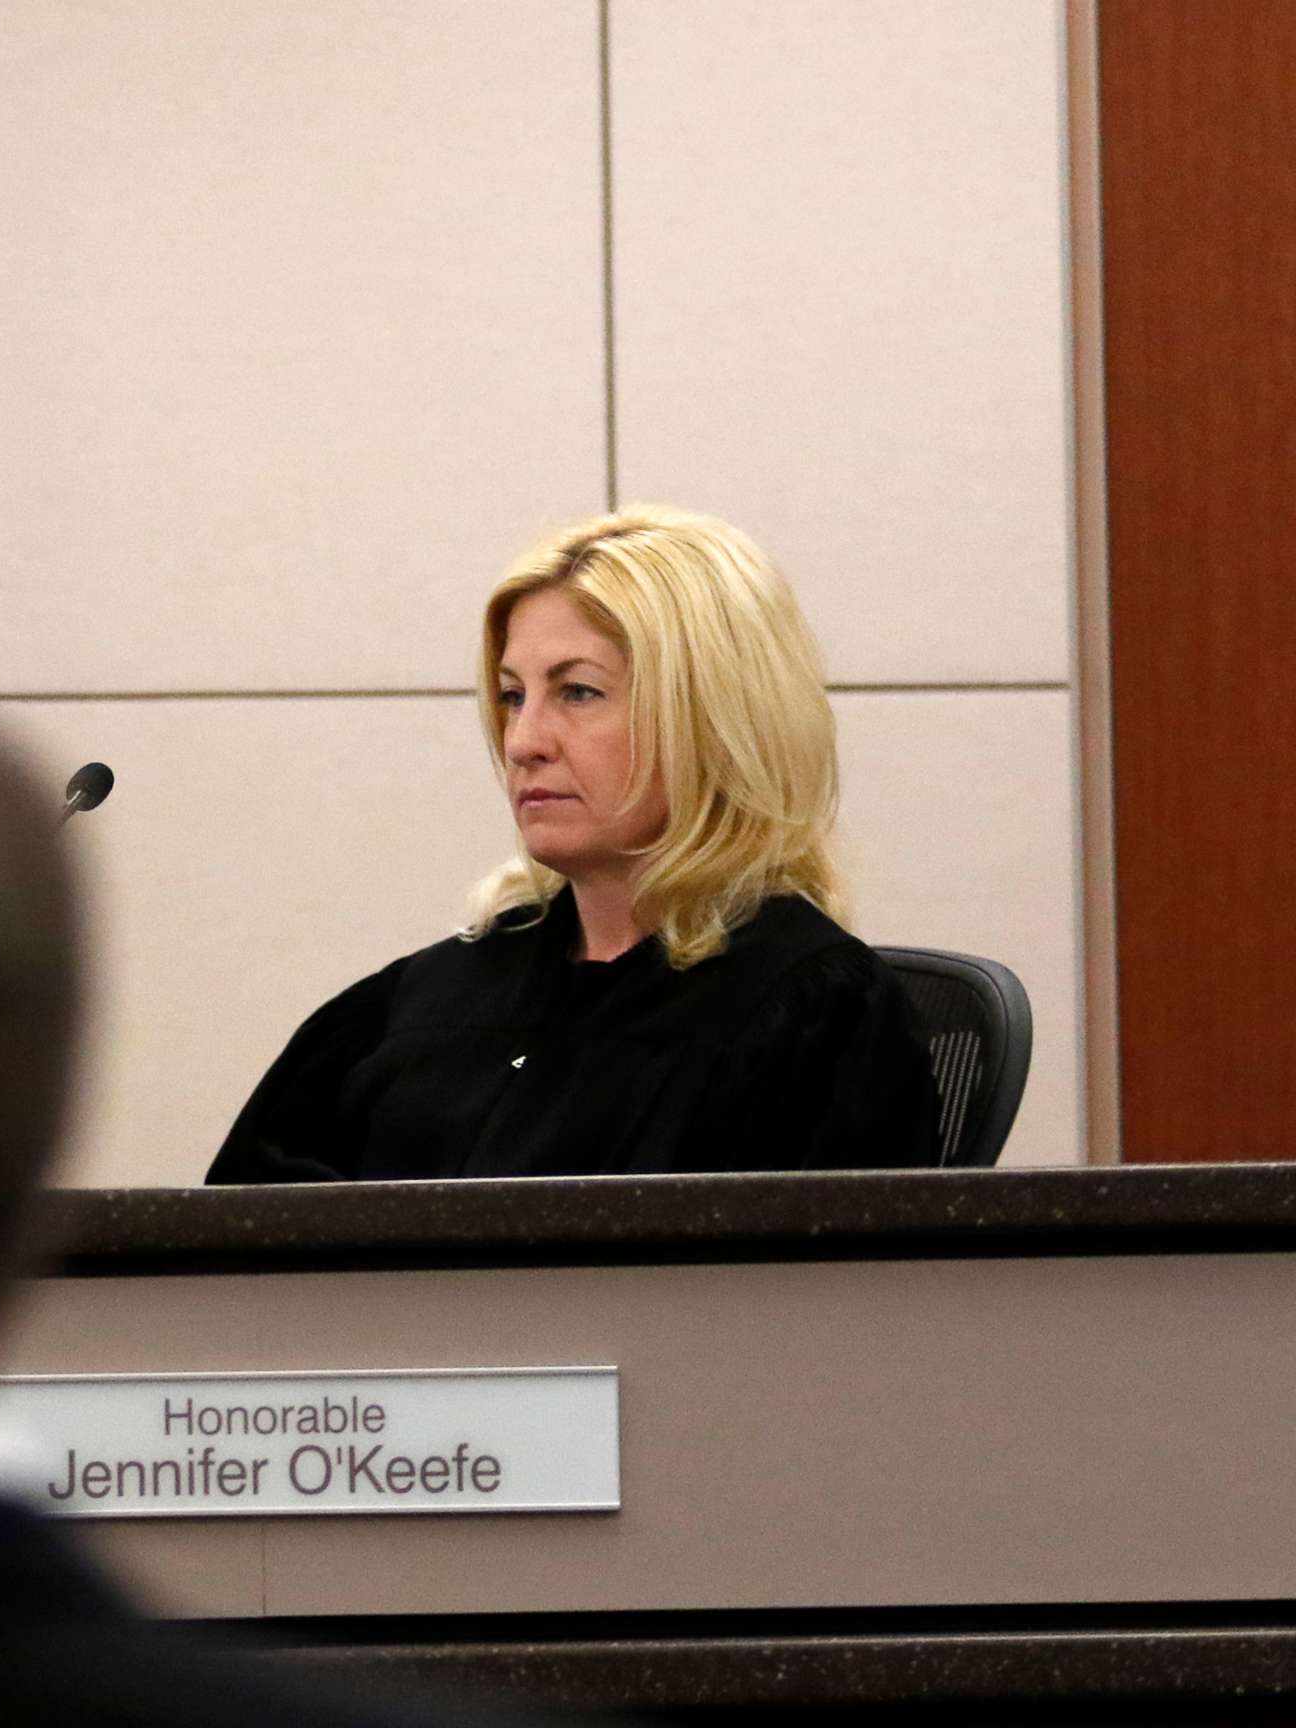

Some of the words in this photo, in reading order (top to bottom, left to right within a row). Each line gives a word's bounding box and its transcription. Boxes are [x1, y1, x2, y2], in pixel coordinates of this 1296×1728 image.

[164, 1395, 386, 1436] Honorable
[48, 1446, 269, 1502] Jennifer
[288, 1442, 502, 1496] O'Keefe
